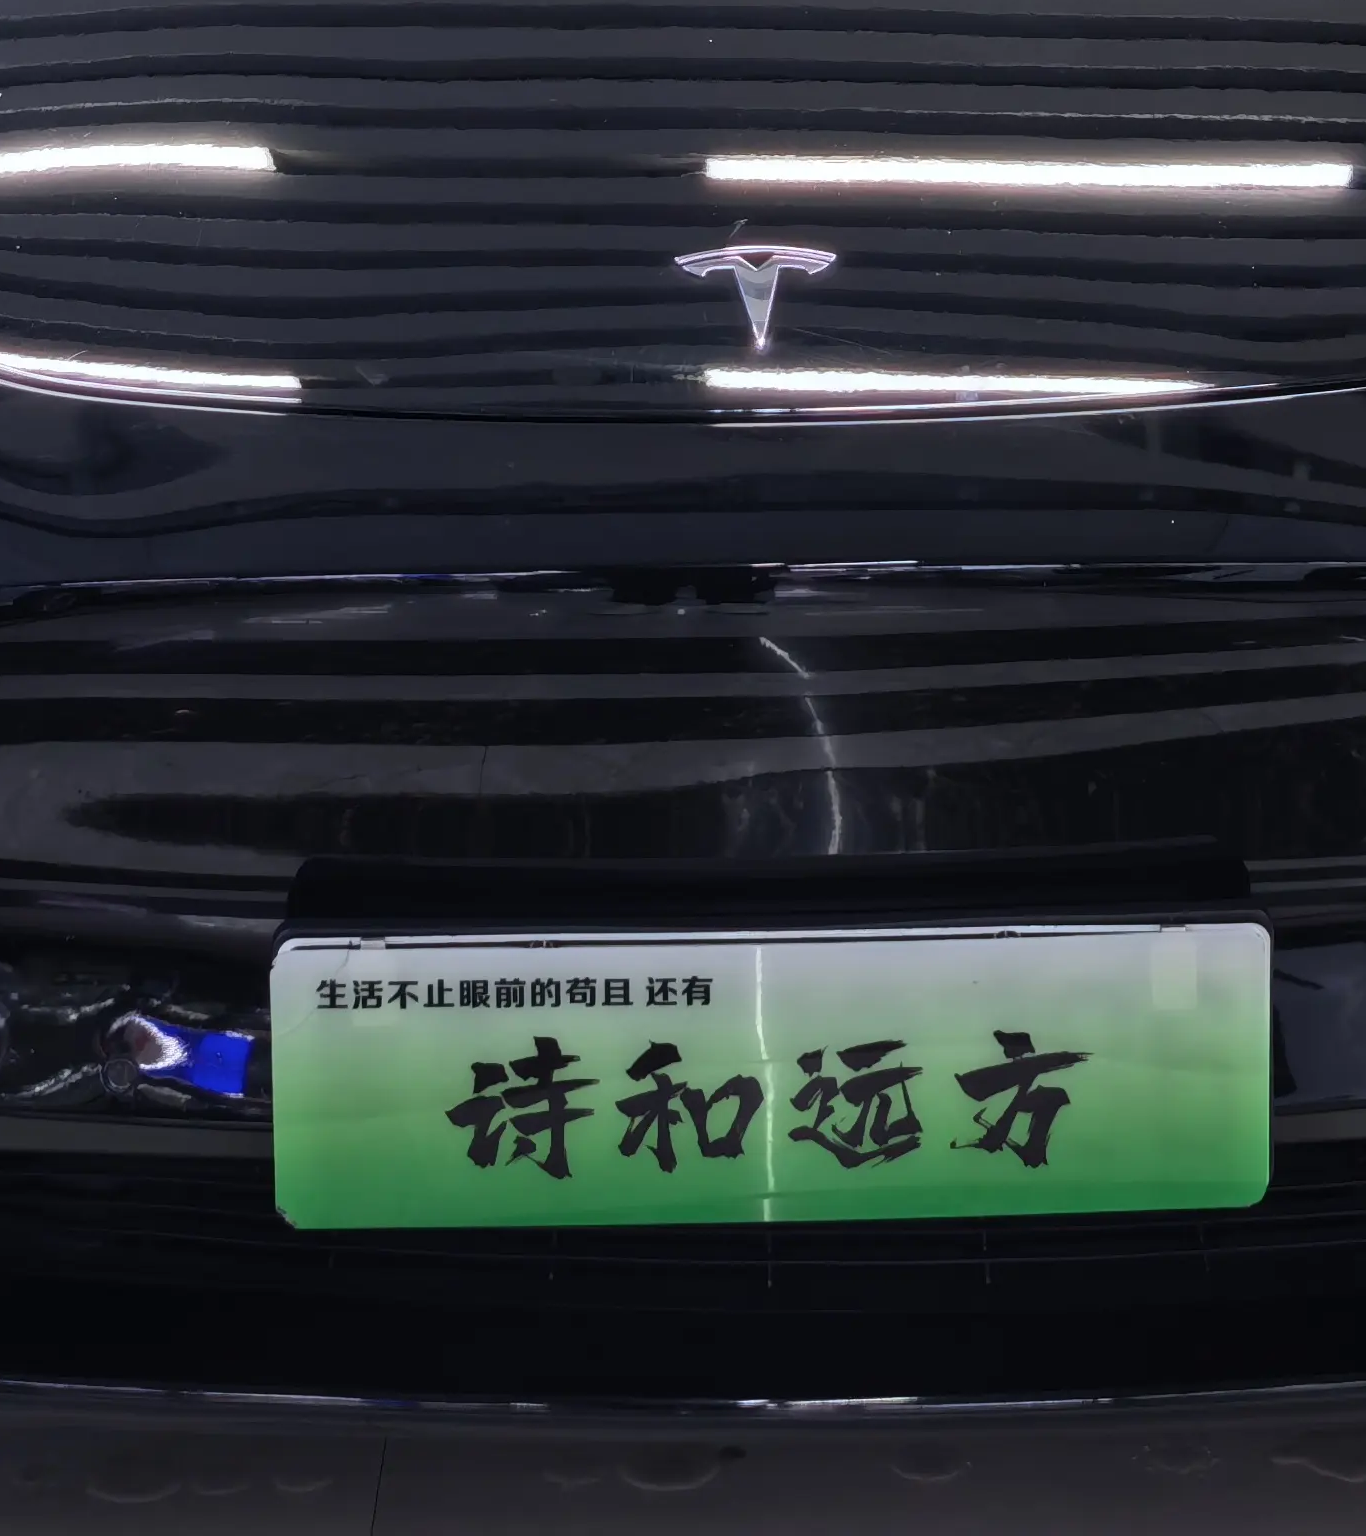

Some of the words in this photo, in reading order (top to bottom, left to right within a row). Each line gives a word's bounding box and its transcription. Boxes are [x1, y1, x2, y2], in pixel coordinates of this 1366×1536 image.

[316, 978, 634, 1011] 生活不止眼前的苟且
[646, 976, 714, 1007] 还有
[445, 1029, 1093, 1181] 诗和远方
